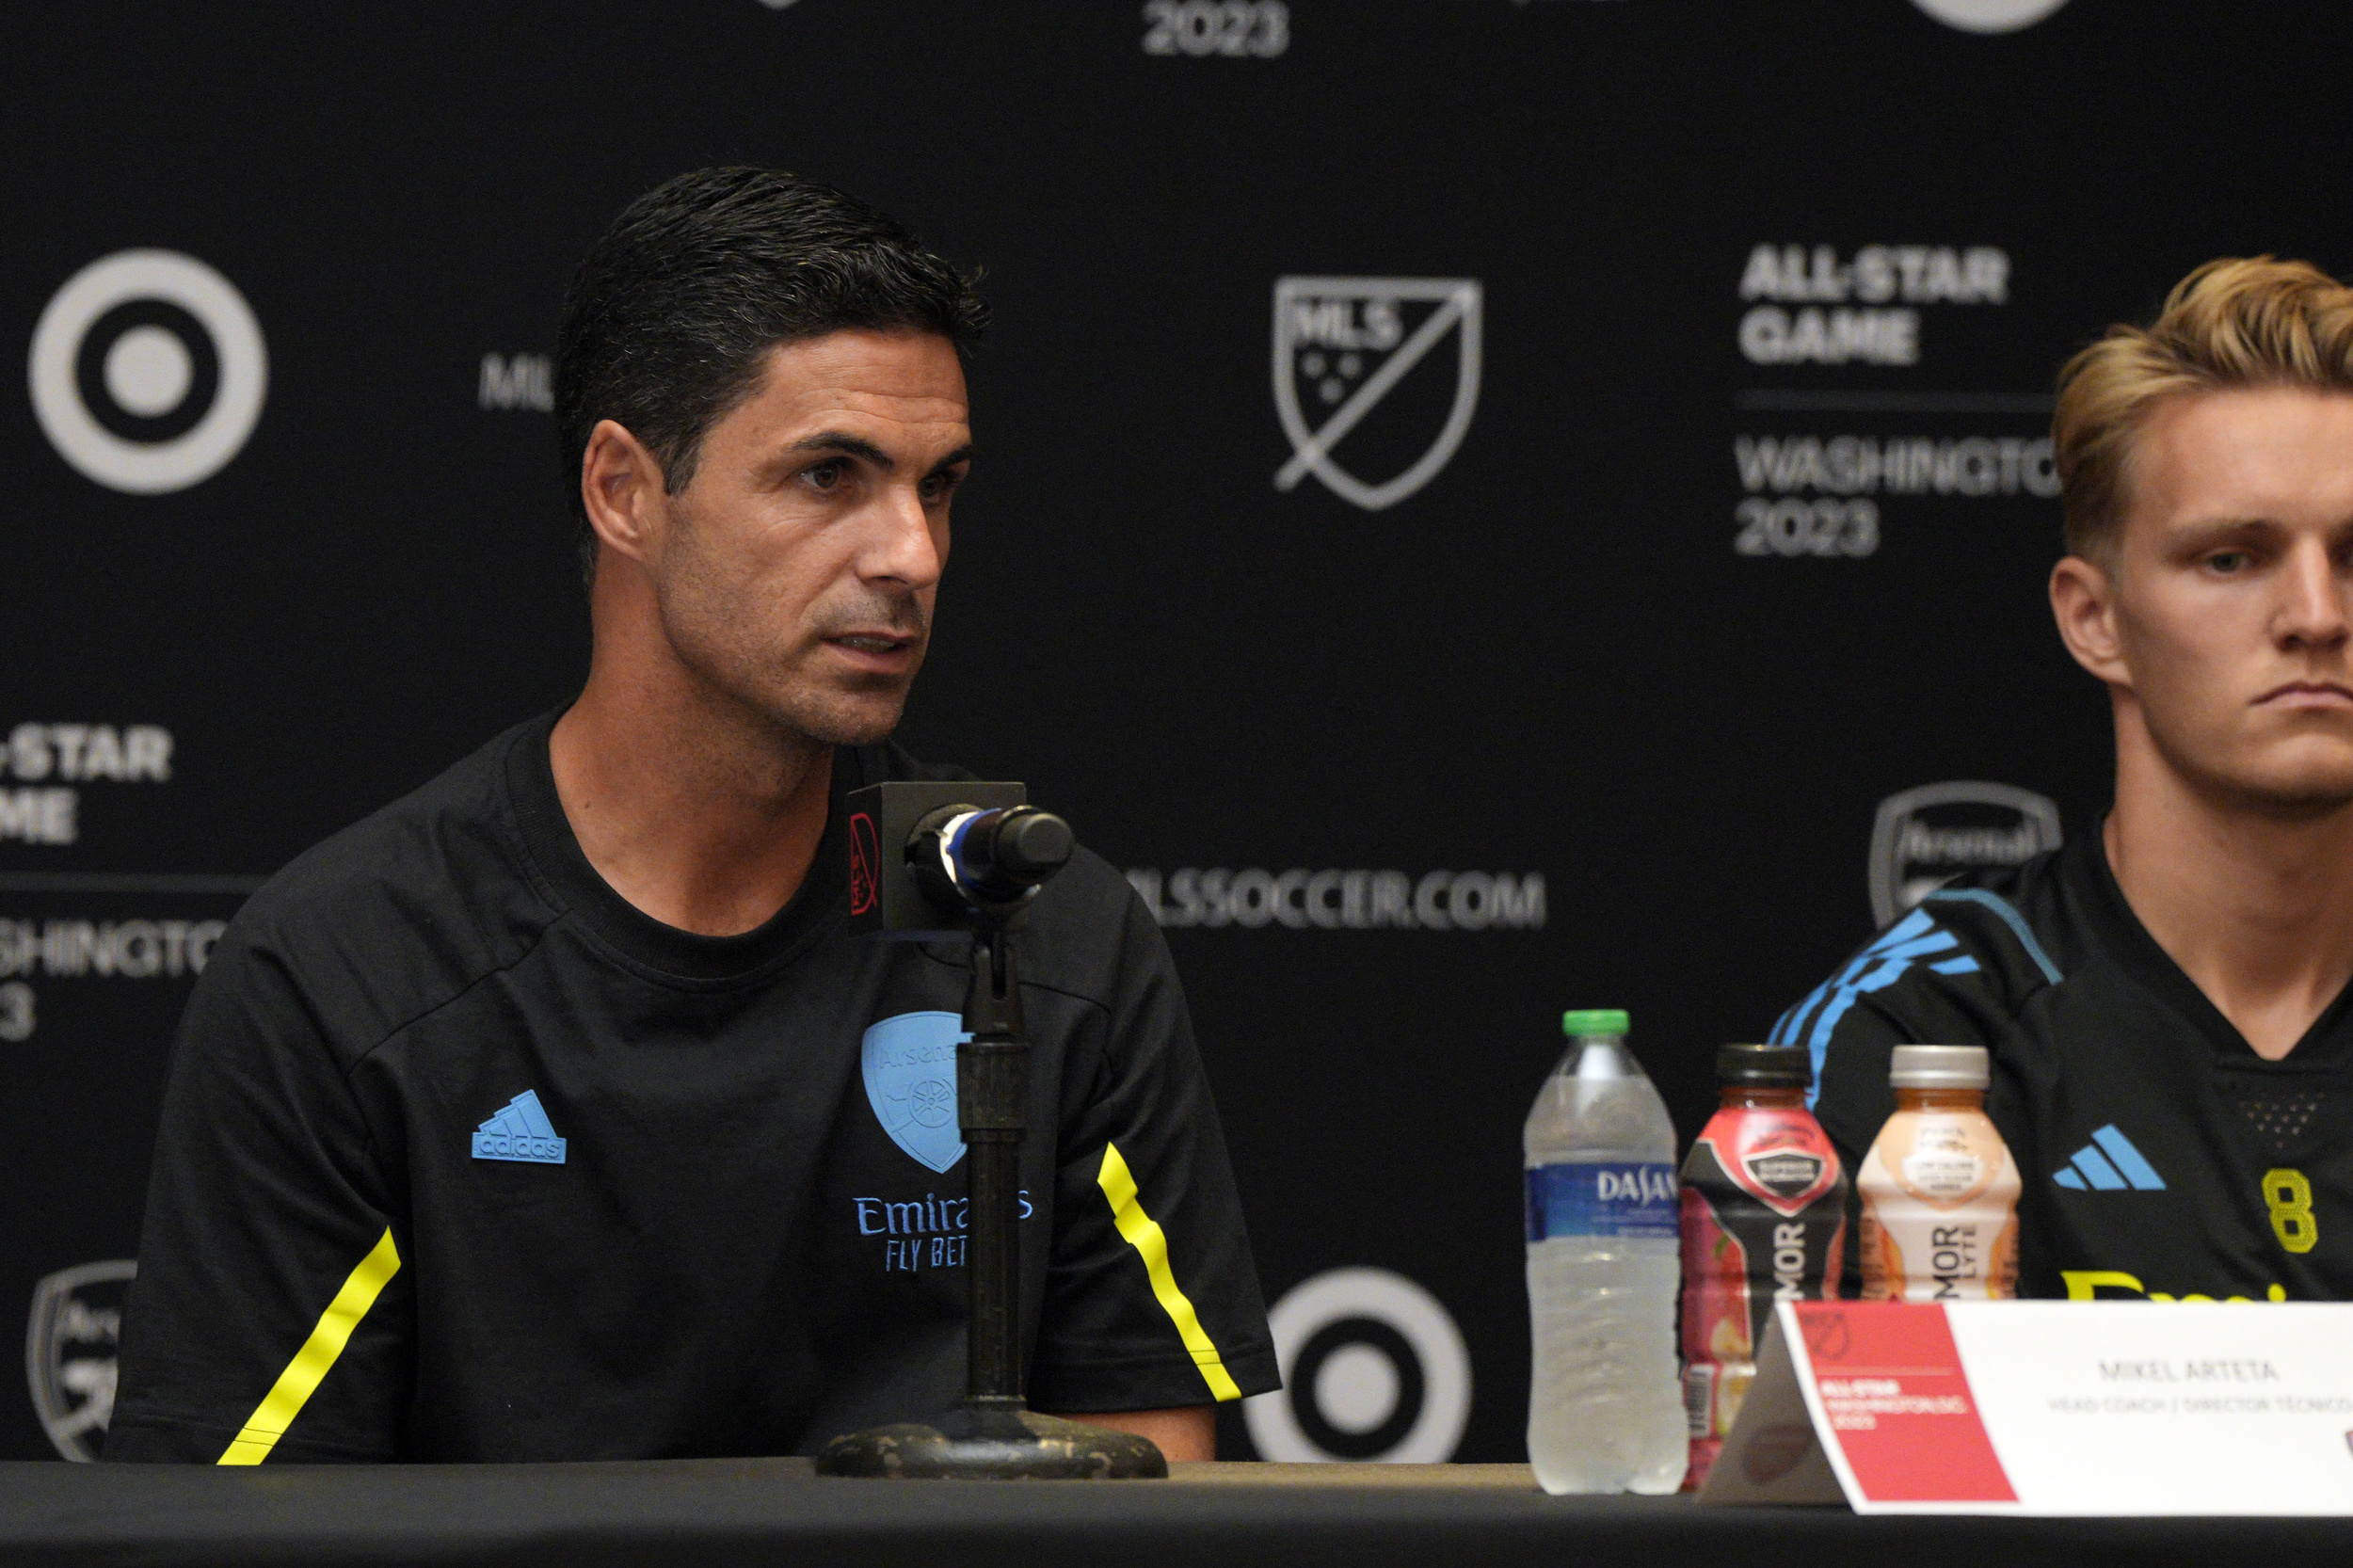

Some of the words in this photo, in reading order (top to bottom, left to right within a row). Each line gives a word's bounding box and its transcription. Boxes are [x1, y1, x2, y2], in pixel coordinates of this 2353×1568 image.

[1142, 0, 1289, 56] 2023
[1739, 245, 2010, 305] ALL-STAR
[1289, 301, 1402, 350] MLS
[1741, 306, 1920, 366] GAME
[1735, 498, 1880, 557] 2023
[479, 1131, 562, 1160] adidas
[852, 1190, 1033, 1236] Emiras
[2262, 1168, 2319, 1254] 8
[886, 1239, 921, 1272] FLY
[1962, 1224, 1976, 1278] LYTE
[2097, 1360, 2179, 1383] MIKEL
[2185, 1360, 2281, 1383] ARTETA
[2104, 1397, 2165, 1413] COACH
